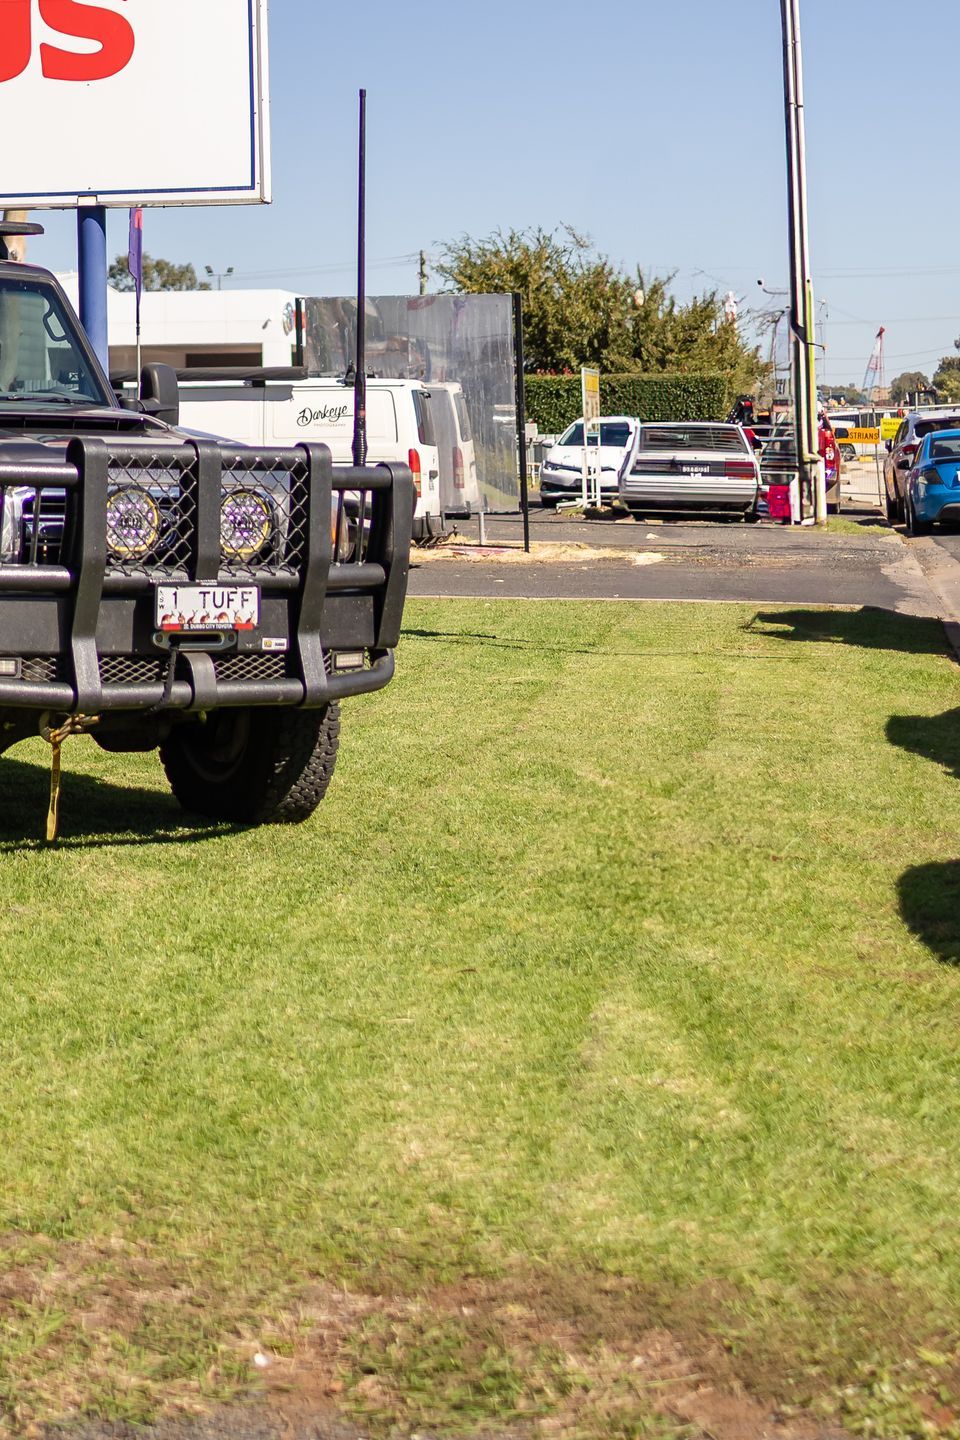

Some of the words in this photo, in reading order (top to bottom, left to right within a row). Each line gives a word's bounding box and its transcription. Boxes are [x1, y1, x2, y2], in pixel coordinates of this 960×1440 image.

[297, 405, 351, 427] Darkeye
[172, 590, 179, 609] 1
[198, 591, 252, 609] TUFF
